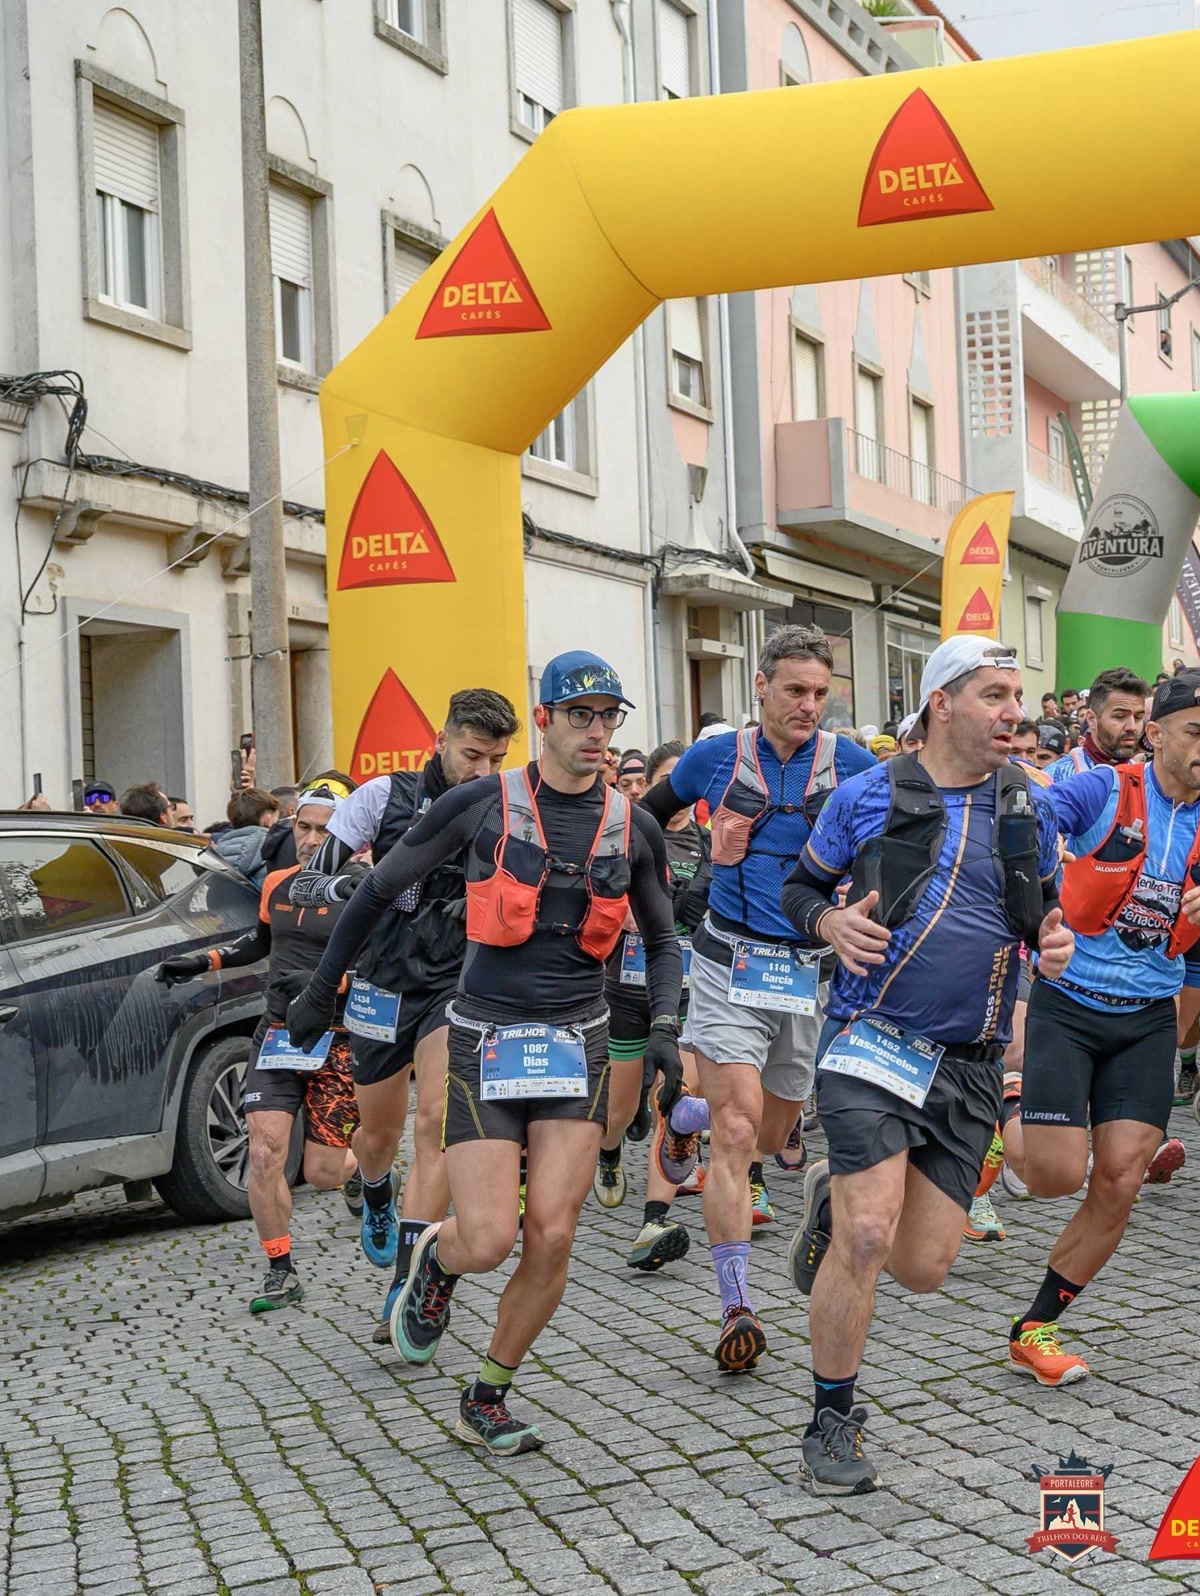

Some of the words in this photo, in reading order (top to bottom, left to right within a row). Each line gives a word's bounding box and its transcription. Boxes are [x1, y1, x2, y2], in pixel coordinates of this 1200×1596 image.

[879, 162, 964, 194] DELTA
[903, 193, 943, 206] CAFÉS
[443, 281, 523, 308] DELTA
[461, 309, 501, 320] CAFÉS
[352, 532, 430, 559] DELTA
[969, 547, 995, 555] DELTA
[1081, 538, 1161, 562] AVENTURA
[369, 561, 407, 572] CAFÉS
[966, 613, 992, 621] DELTA
[360, 750, 431, 775] DELTA
[1095, 865, 1127, 873] SALOMON
[753, 946, 790, 958] TRILHOS
[769, 962, 790, 973] 1140
[989, 946, 1003, 992] TRAIL
[762, 972, 793, 986] García
[354, 994, 370, 1004] 1434
[502, 1028, 546, 1039] TRILHOS
[522, 1043, 548, 1053] 1087
[876, 1034, 900, 1053] 1452
[849, 1034, 919, 1075] Vasconcelos
[523, 1056, 549, 1067] Dias
[1024, 1111, 1070, 1122] LURBEL
